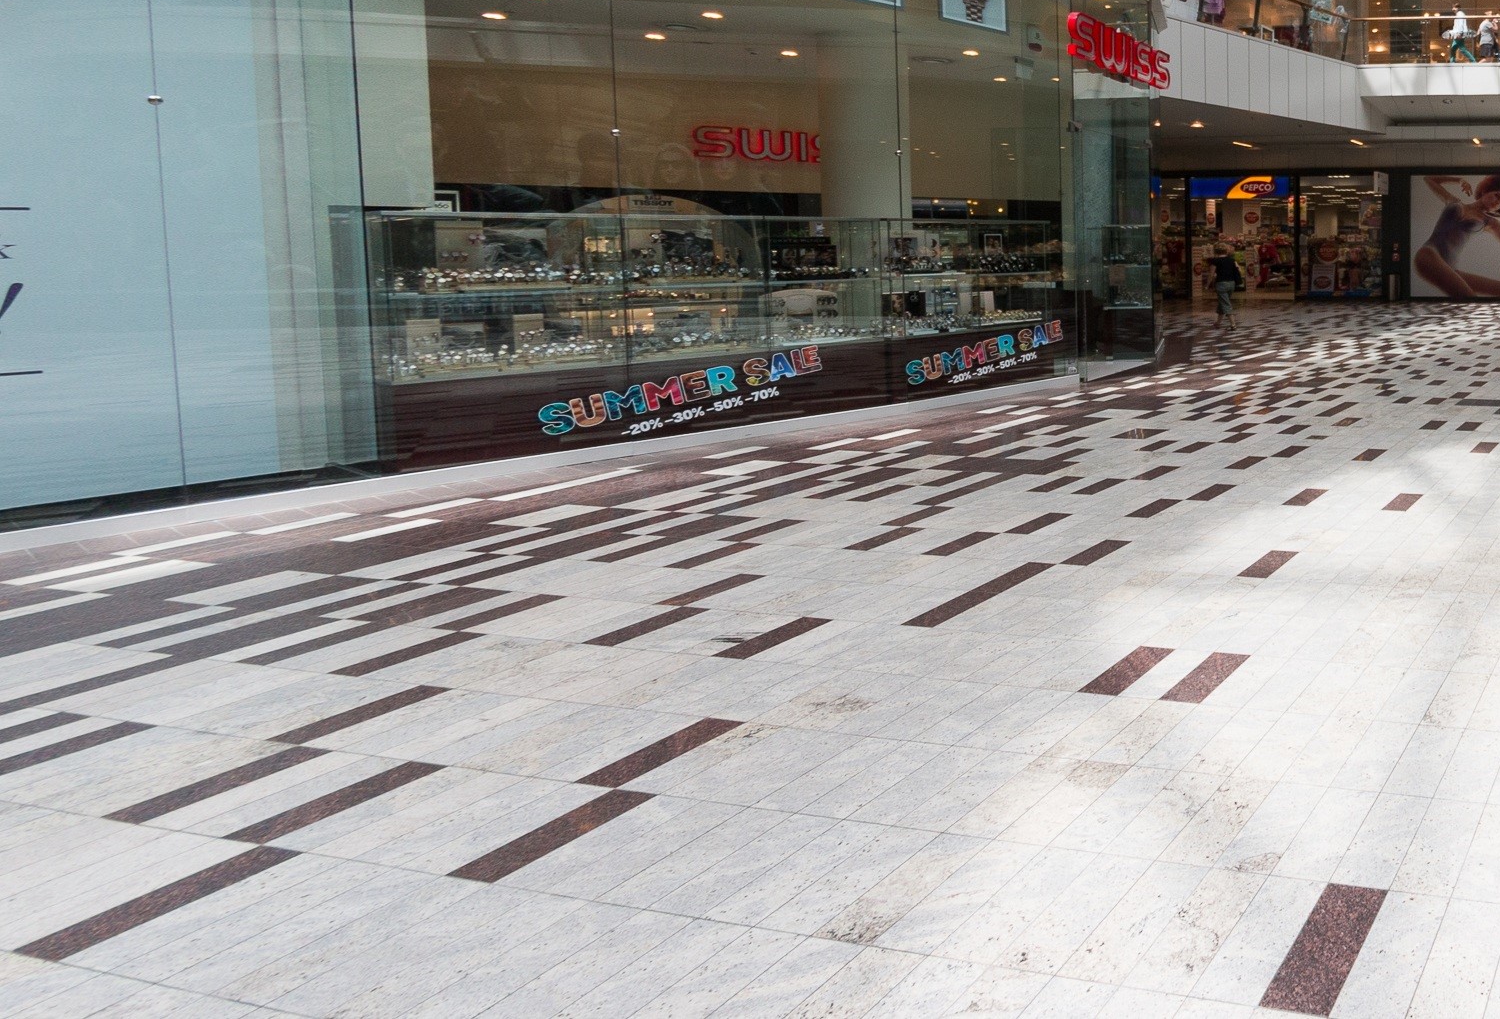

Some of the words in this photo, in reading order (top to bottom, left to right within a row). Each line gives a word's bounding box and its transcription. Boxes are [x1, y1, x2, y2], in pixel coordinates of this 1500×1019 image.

[1067, 10, 1172, 90] SWISS
[631, 199, 675, 207] TISSOT
[1242, 182, 1273, 192] PEPCO
[904, 334, 1016, 386] SUMMER
[1017, 319, 1064, 352] SALE
[947, 371, 972, 384] -20%
[971, 363, 995, 377] -30%
[994, 357, 1017, 369] -50%
[1016, 351, 1038, 363] -70%
[538, 365, 737, 436] SUMMER
[743, 345, 823, 386] SALE
[620, 417, 664, 436] -20%
[664, 406, 706, 424] -30%
[705, 395, 744, 412] -50%
[744, 386, 780, 404] -70%
